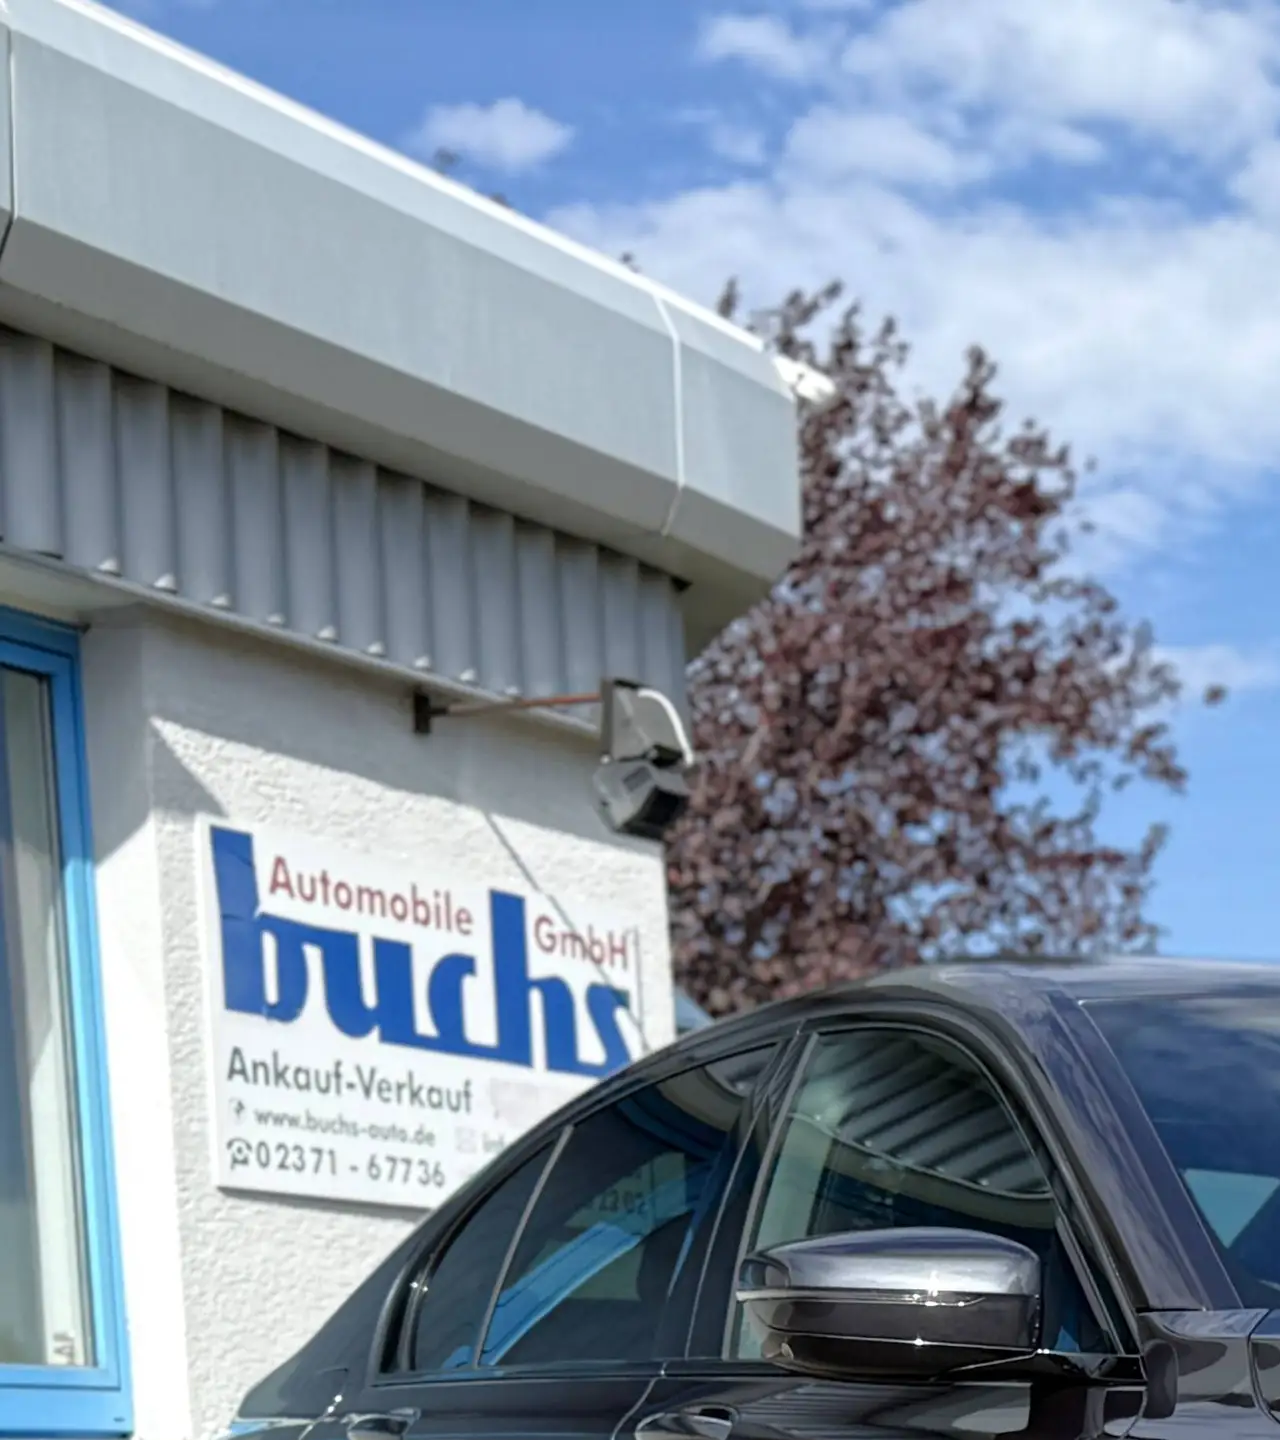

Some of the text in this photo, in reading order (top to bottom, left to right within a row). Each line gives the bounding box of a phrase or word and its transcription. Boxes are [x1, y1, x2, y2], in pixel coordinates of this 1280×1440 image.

[269, 856, 473, 936] Automobile
[210, 825, 634, 1078] buchs
[533, 914, 630, 972] GmbH
[227, 1046, 474, 1113] Ankauf-Verkauf
[254, 1107, 436, 1146] www.buchs-auto.de
[255, 1140, 338, 1176] 02371
[367, 1152, 446, 1188] 67736
